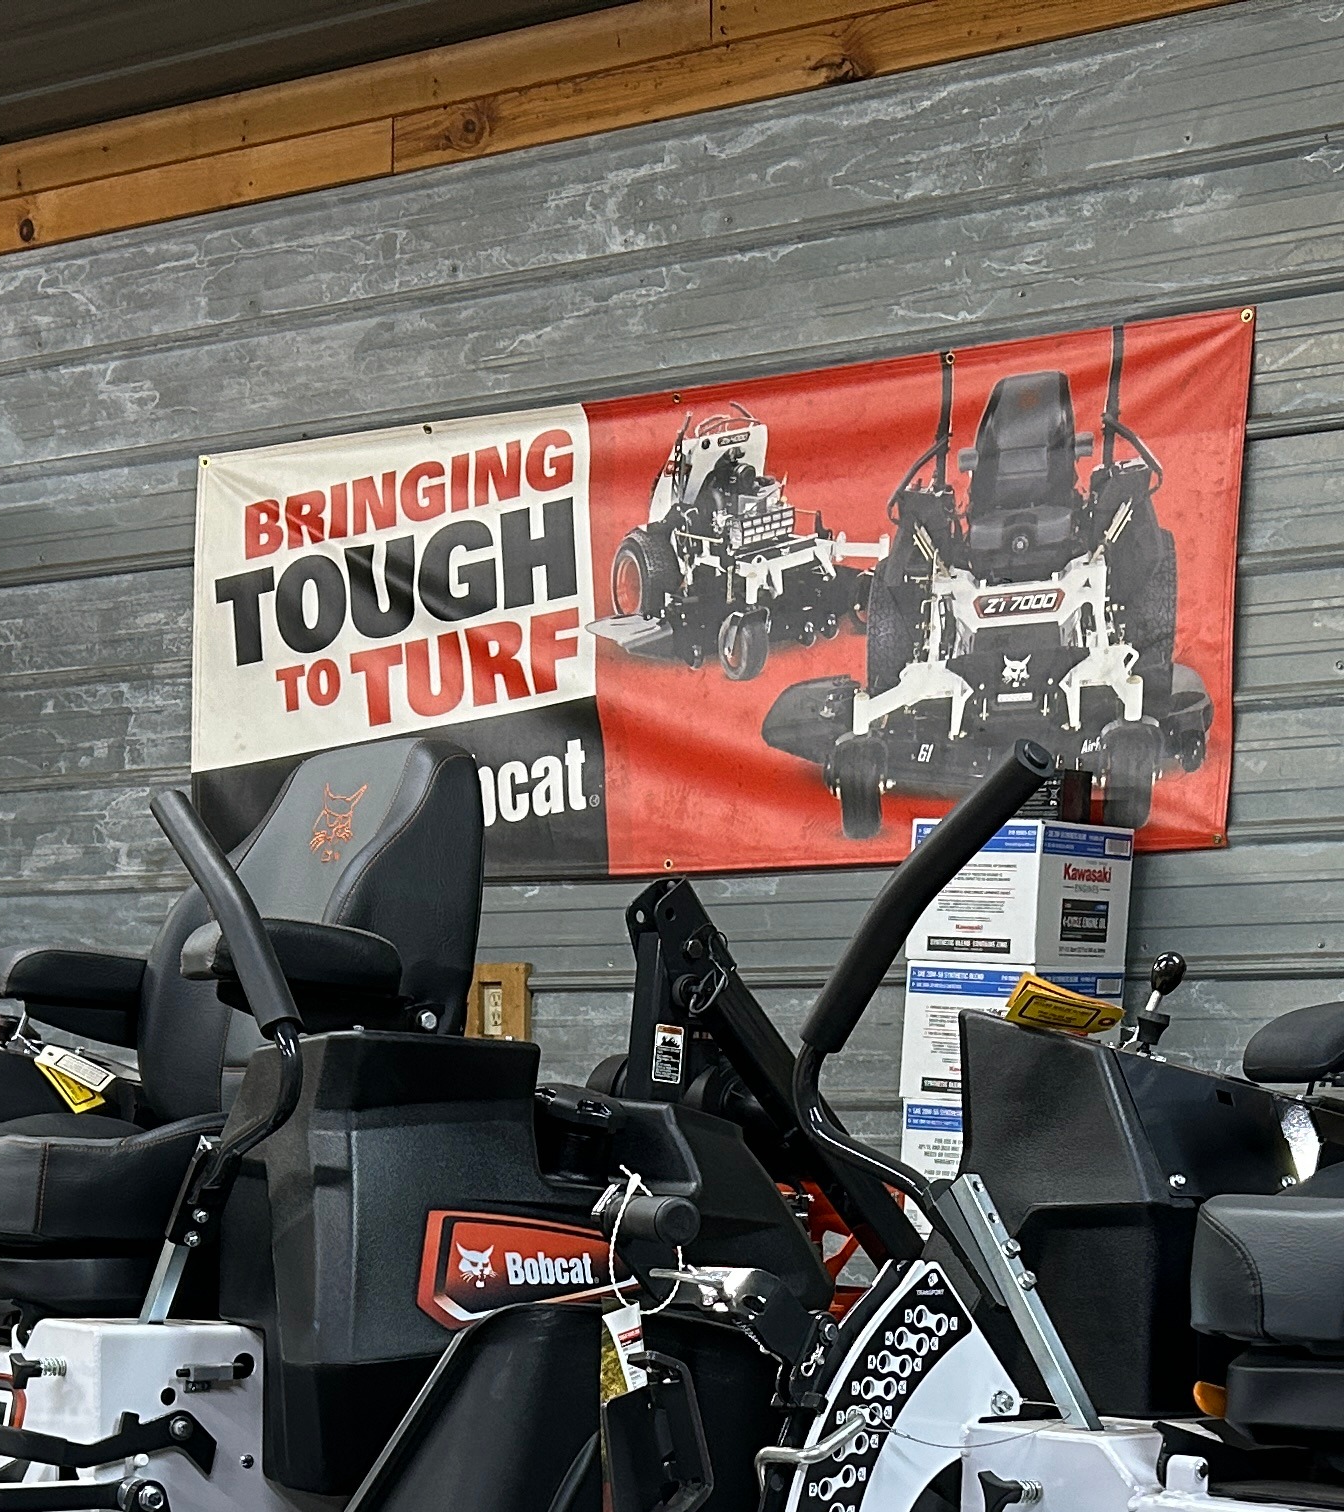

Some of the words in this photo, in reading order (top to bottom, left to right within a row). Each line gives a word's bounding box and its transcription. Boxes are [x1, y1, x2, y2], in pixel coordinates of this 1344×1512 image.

[244, 428, 574, 560] BRINGING
[214, 496, 579, 667] TOUGH
[275, 658, 342, 712] TO
[350, 607, 579, 727] TURF
[1063, 863, 1111, 883] Kawasaki
[505, 1251, 594, 1285] Bobcat
